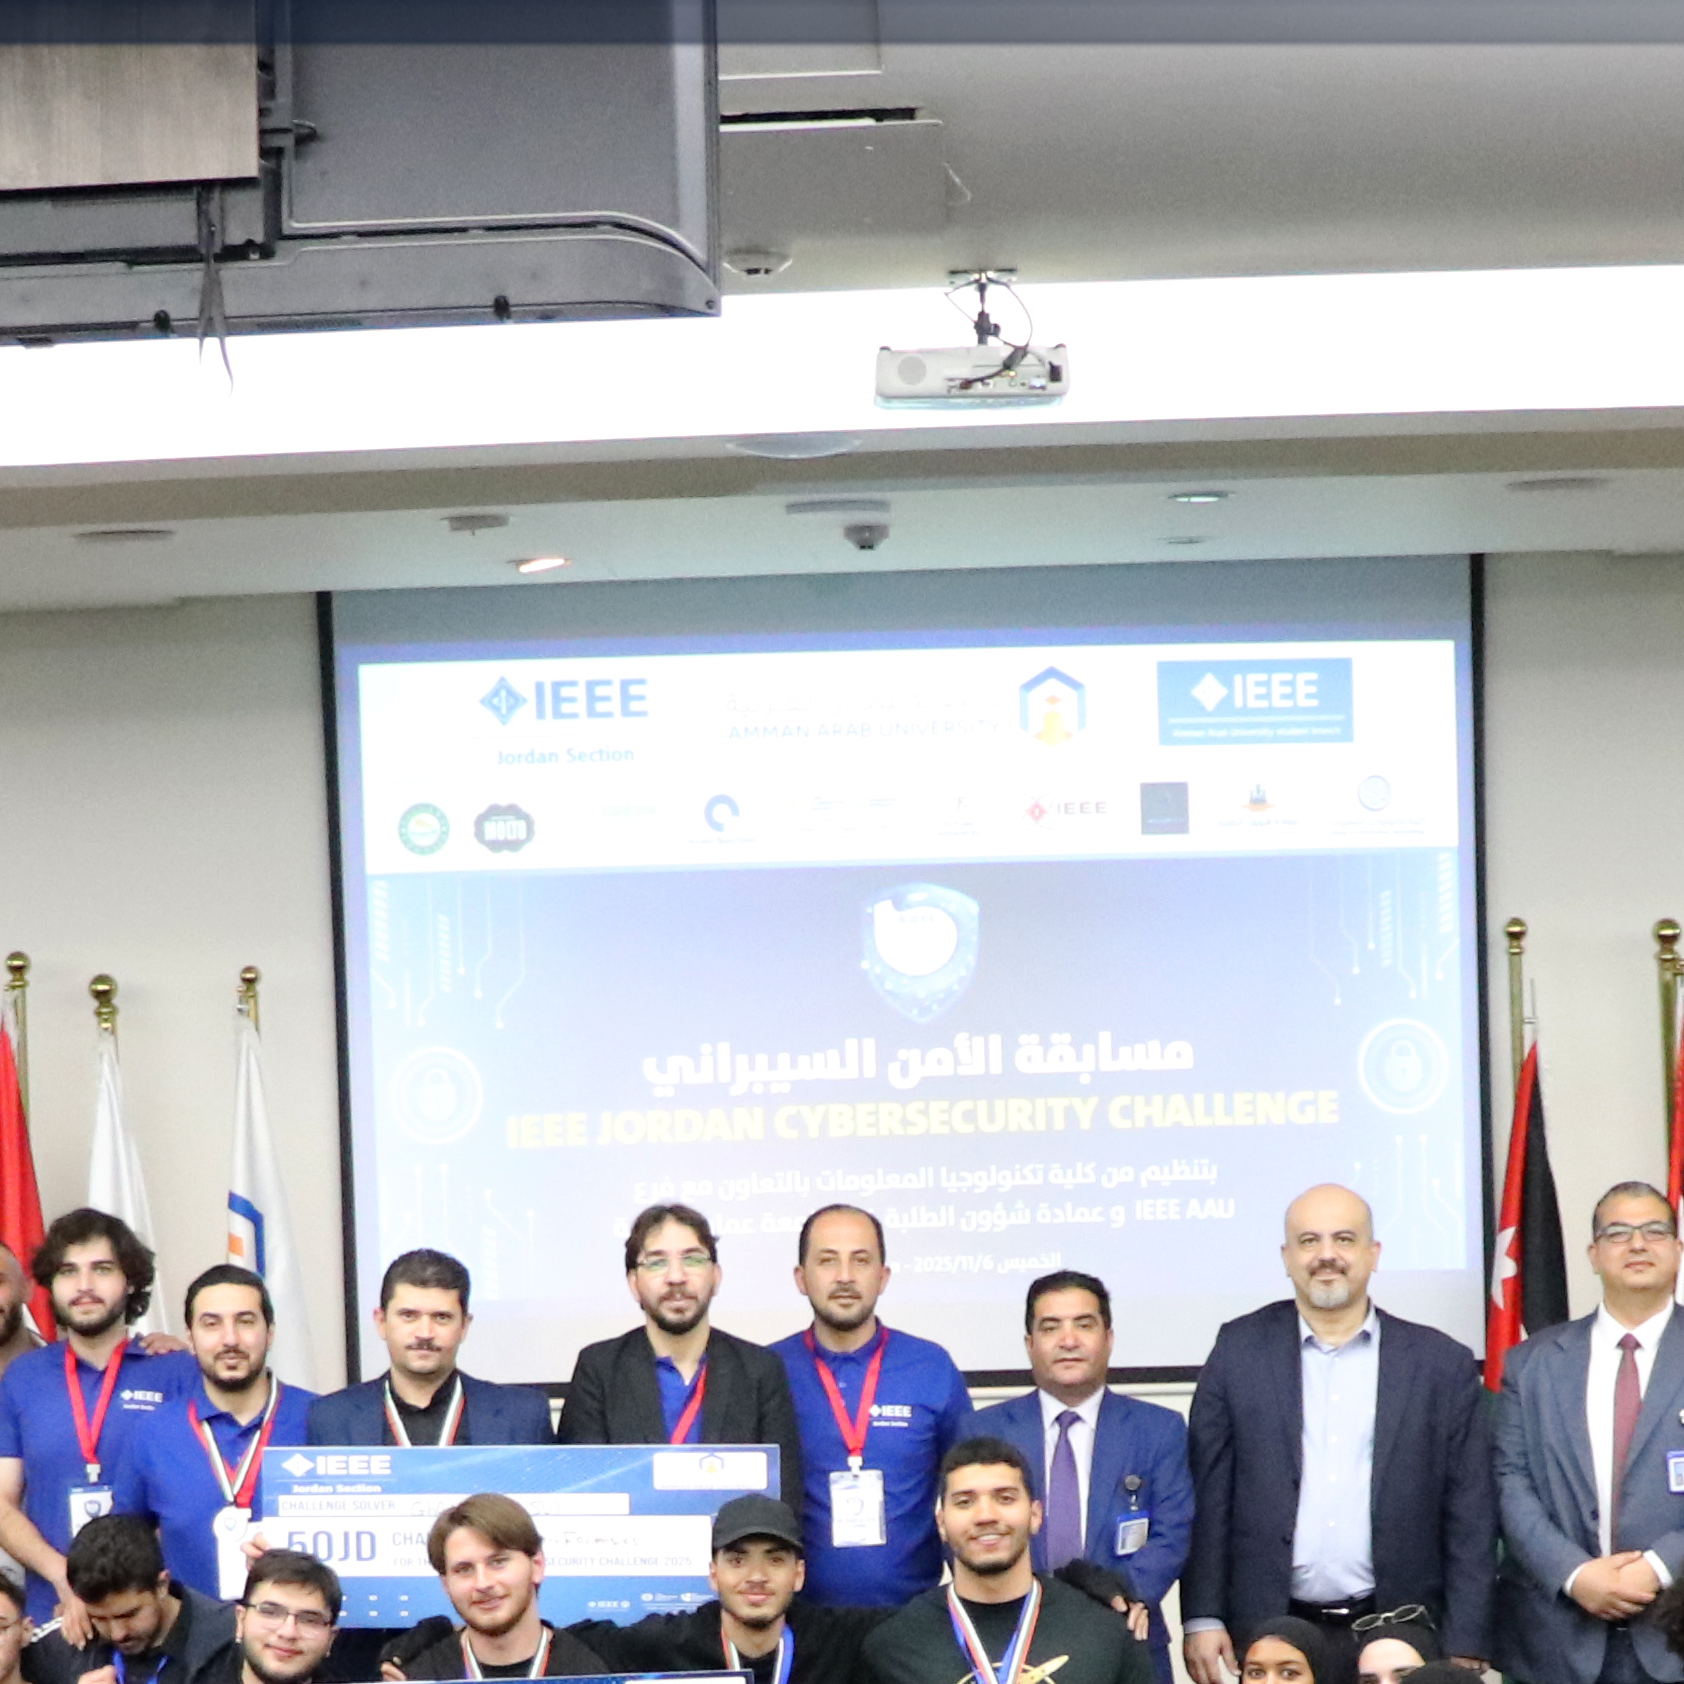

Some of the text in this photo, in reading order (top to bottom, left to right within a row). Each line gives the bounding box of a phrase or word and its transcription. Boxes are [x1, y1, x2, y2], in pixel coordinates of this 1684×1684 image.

[534, 678, 649, 721] IEEE
[1233, 672, 1319, 709] IEEE
[728, 718, 1001, 741] AMMAN ARAB UNIVERSITY
[497, 745, 635, 766] Jordan Section
[1056, 801, 1108, 815] IEEE
[642, 1030, 1195, 1097] مسابقة الأمن السيبراني
[506, 1089, 1340, 1149] IEEE JORDAN CYBERSECURITY CHALLENGE
[717, 1171, 811, 1200] بالتعاون
[816, 1166, 935, 1196] المعلومات
[940, 1164, 1045, 1194] تكنولوجيا
[1048, 1162, 1096, 1188] كلية
[1100, 1163, 1135, 1189] من
[1140, 1158, 1218, 1187] بتنظيم
[680, 1179, 713, 1200] مع
[884, 1198, 1235, 1233] IEEE AAU و عمادة شؤون الطلبة
[914, 1252, 1061, 1274] الخميس 2025/11/6
[133, 1389, 164, 1403] IEEE
[881, 1403, 913, 1417] IEEE
[316, 1454, 392, 1476] IEEE
[292, 1483, 382, 1495] Jordan Section
[281, 1499, 396, 1512] CHALLENGE SOLVER
[286, 1530, 377, 1564] 50JD
[598, 1556, 660, 1567] CHALLENGE
